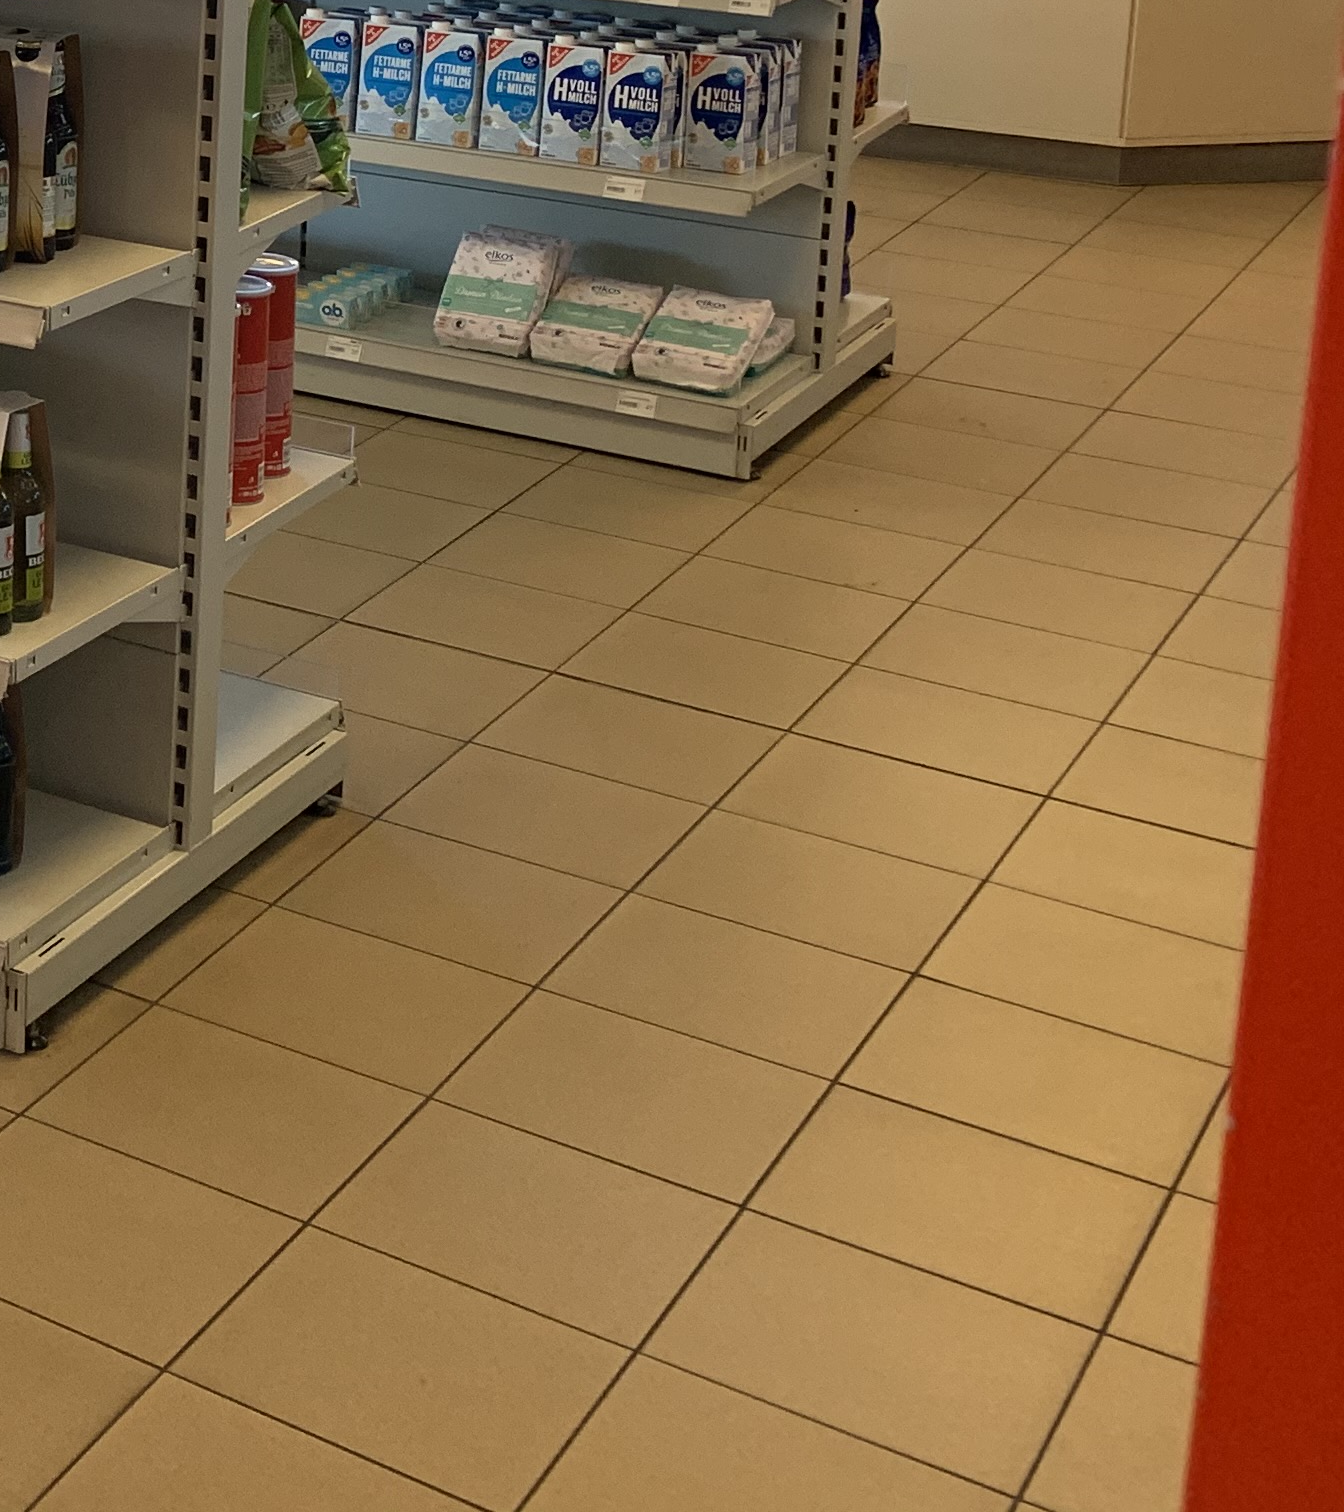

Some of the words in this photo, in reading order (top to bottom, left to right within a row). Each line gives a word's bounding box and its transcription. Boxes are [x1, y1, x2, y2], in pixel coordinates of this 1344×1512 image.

[373, 54, 412, 70] FETTARME
[434, 61, 472, 77] FETTARME
[372, 65, 411, 81] H-MILCH
[432, 73, 471, 89] H-MILCH
[497, 68, 537, 84] FETTARME
[496, 80, 537, 96] H-MILCH
[553, 76, 569, 102] H
[569, 78, 597, 94] VOLL
[568, 90, 597, 105] MILCH
[614, 84, 629, 109] H
[630, 86, 659, 102] VOLL
[696, 85, 712, 110] H
[713, 87, 742, 103] VOLL
[628, 97, 659, 113] MILCH
[711, 98, 742, 114] MILCH
